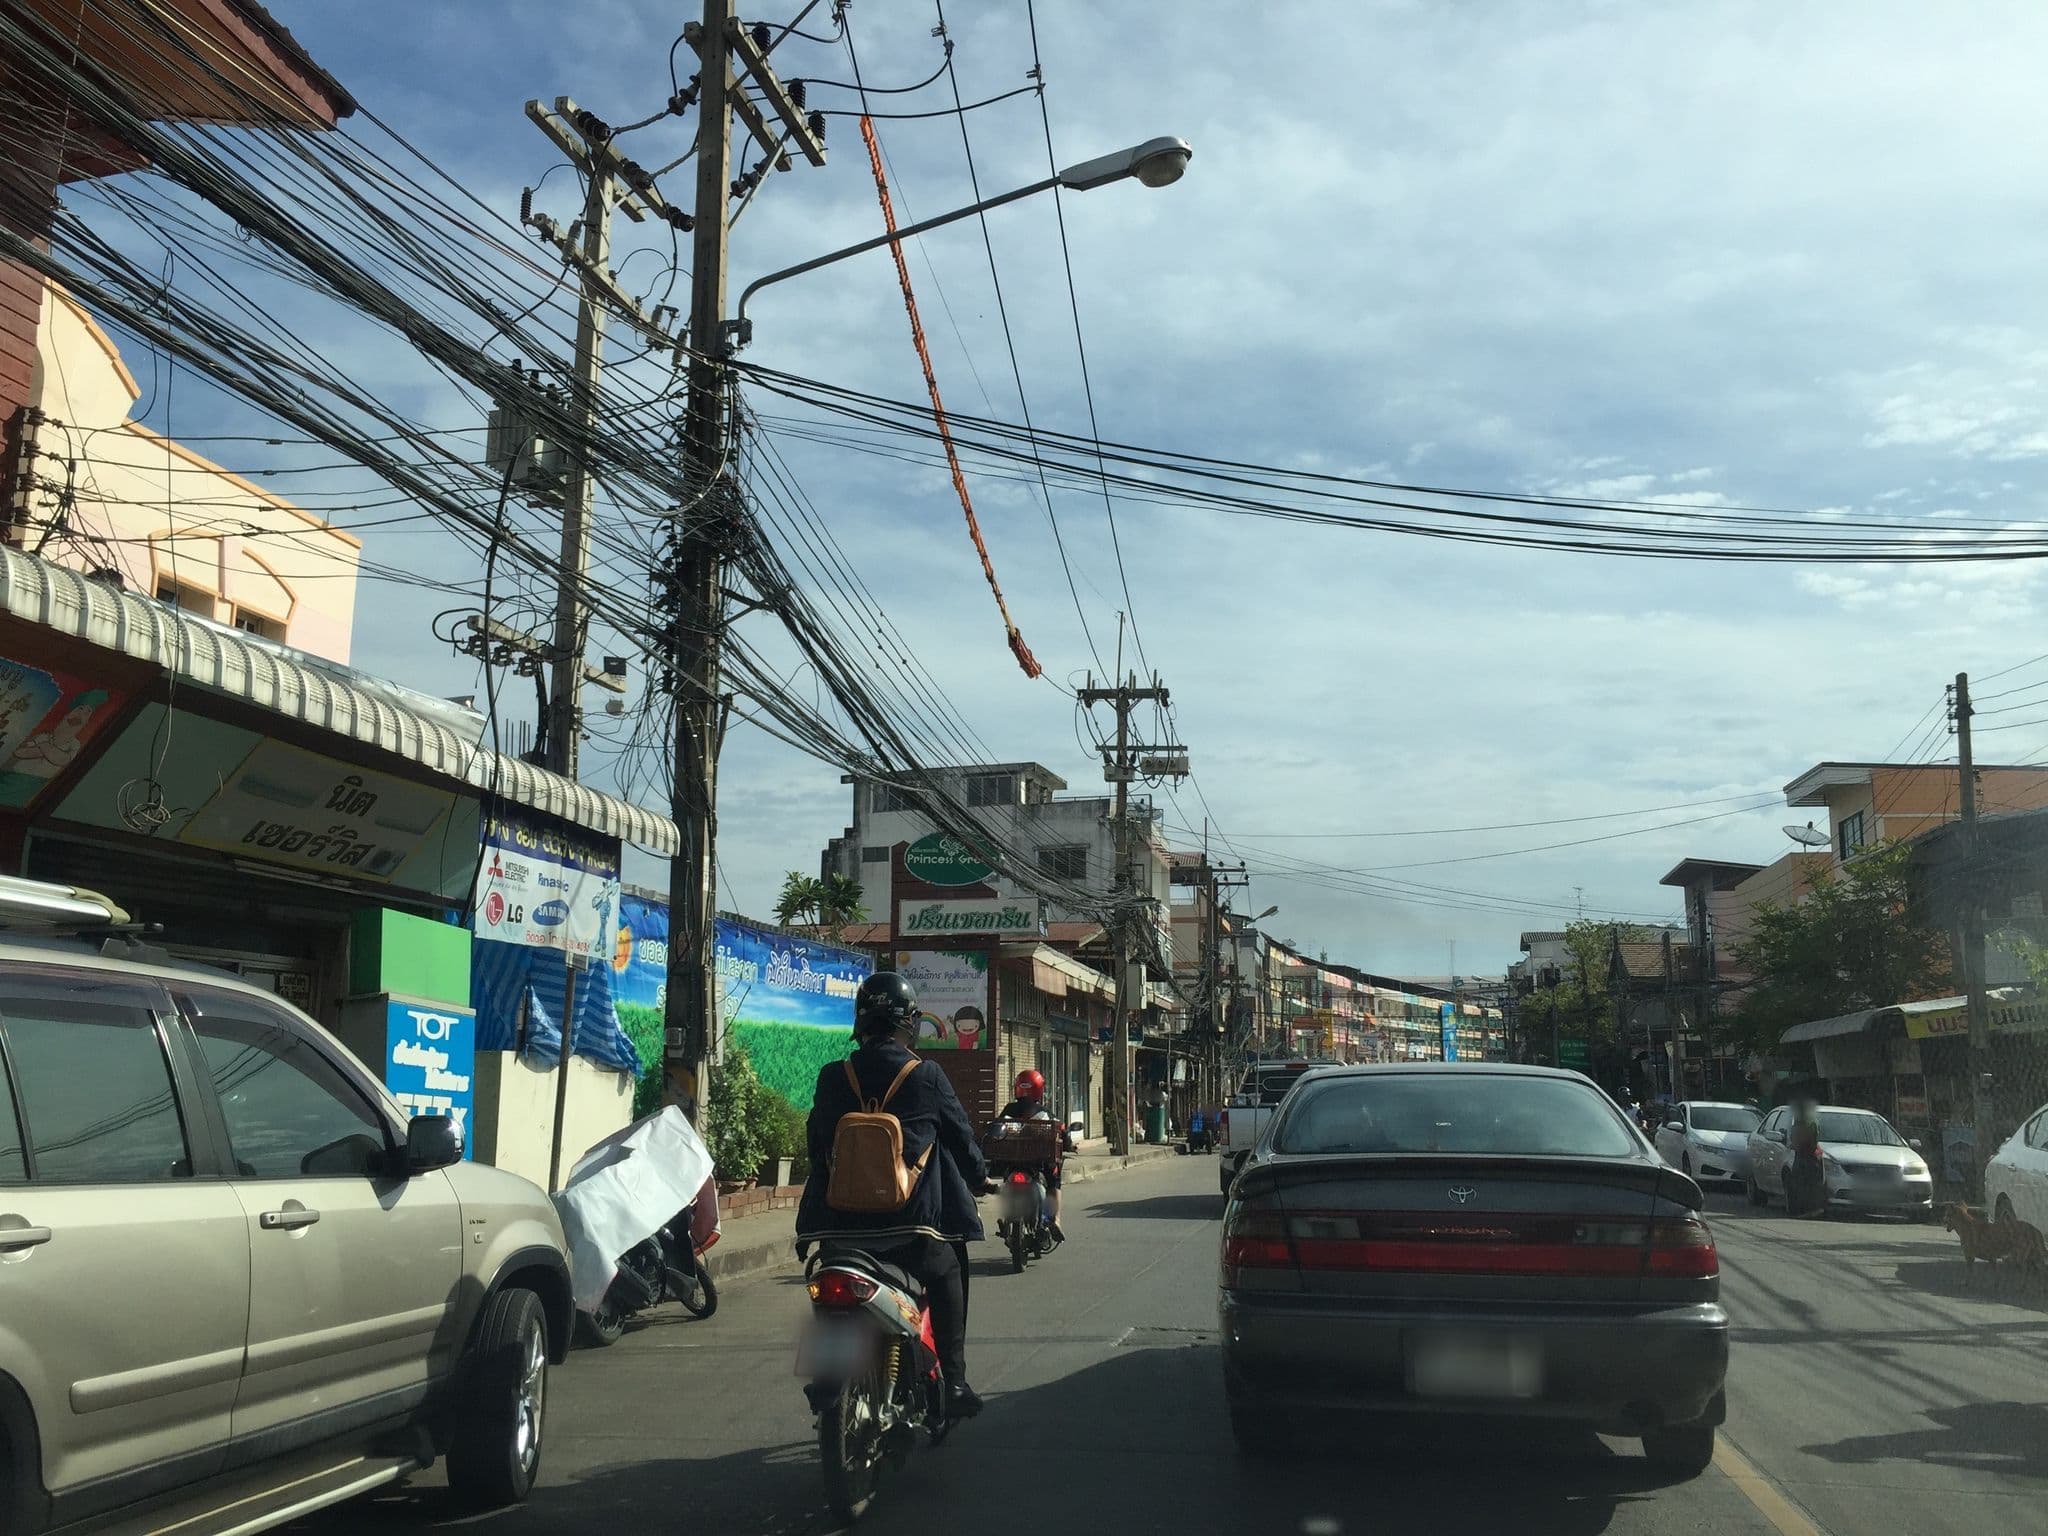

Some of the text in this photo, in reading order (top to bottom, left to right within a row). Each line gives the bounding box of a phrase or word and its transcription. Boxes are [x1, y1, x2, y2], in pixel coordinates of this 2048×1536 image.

[241, 820, 376, 866] เซอร์วิส
[907, 853, 997, 865] Princess Gre
[507, 903, 524, 924] LG
[407, 1010, 460, 1041] TOT
